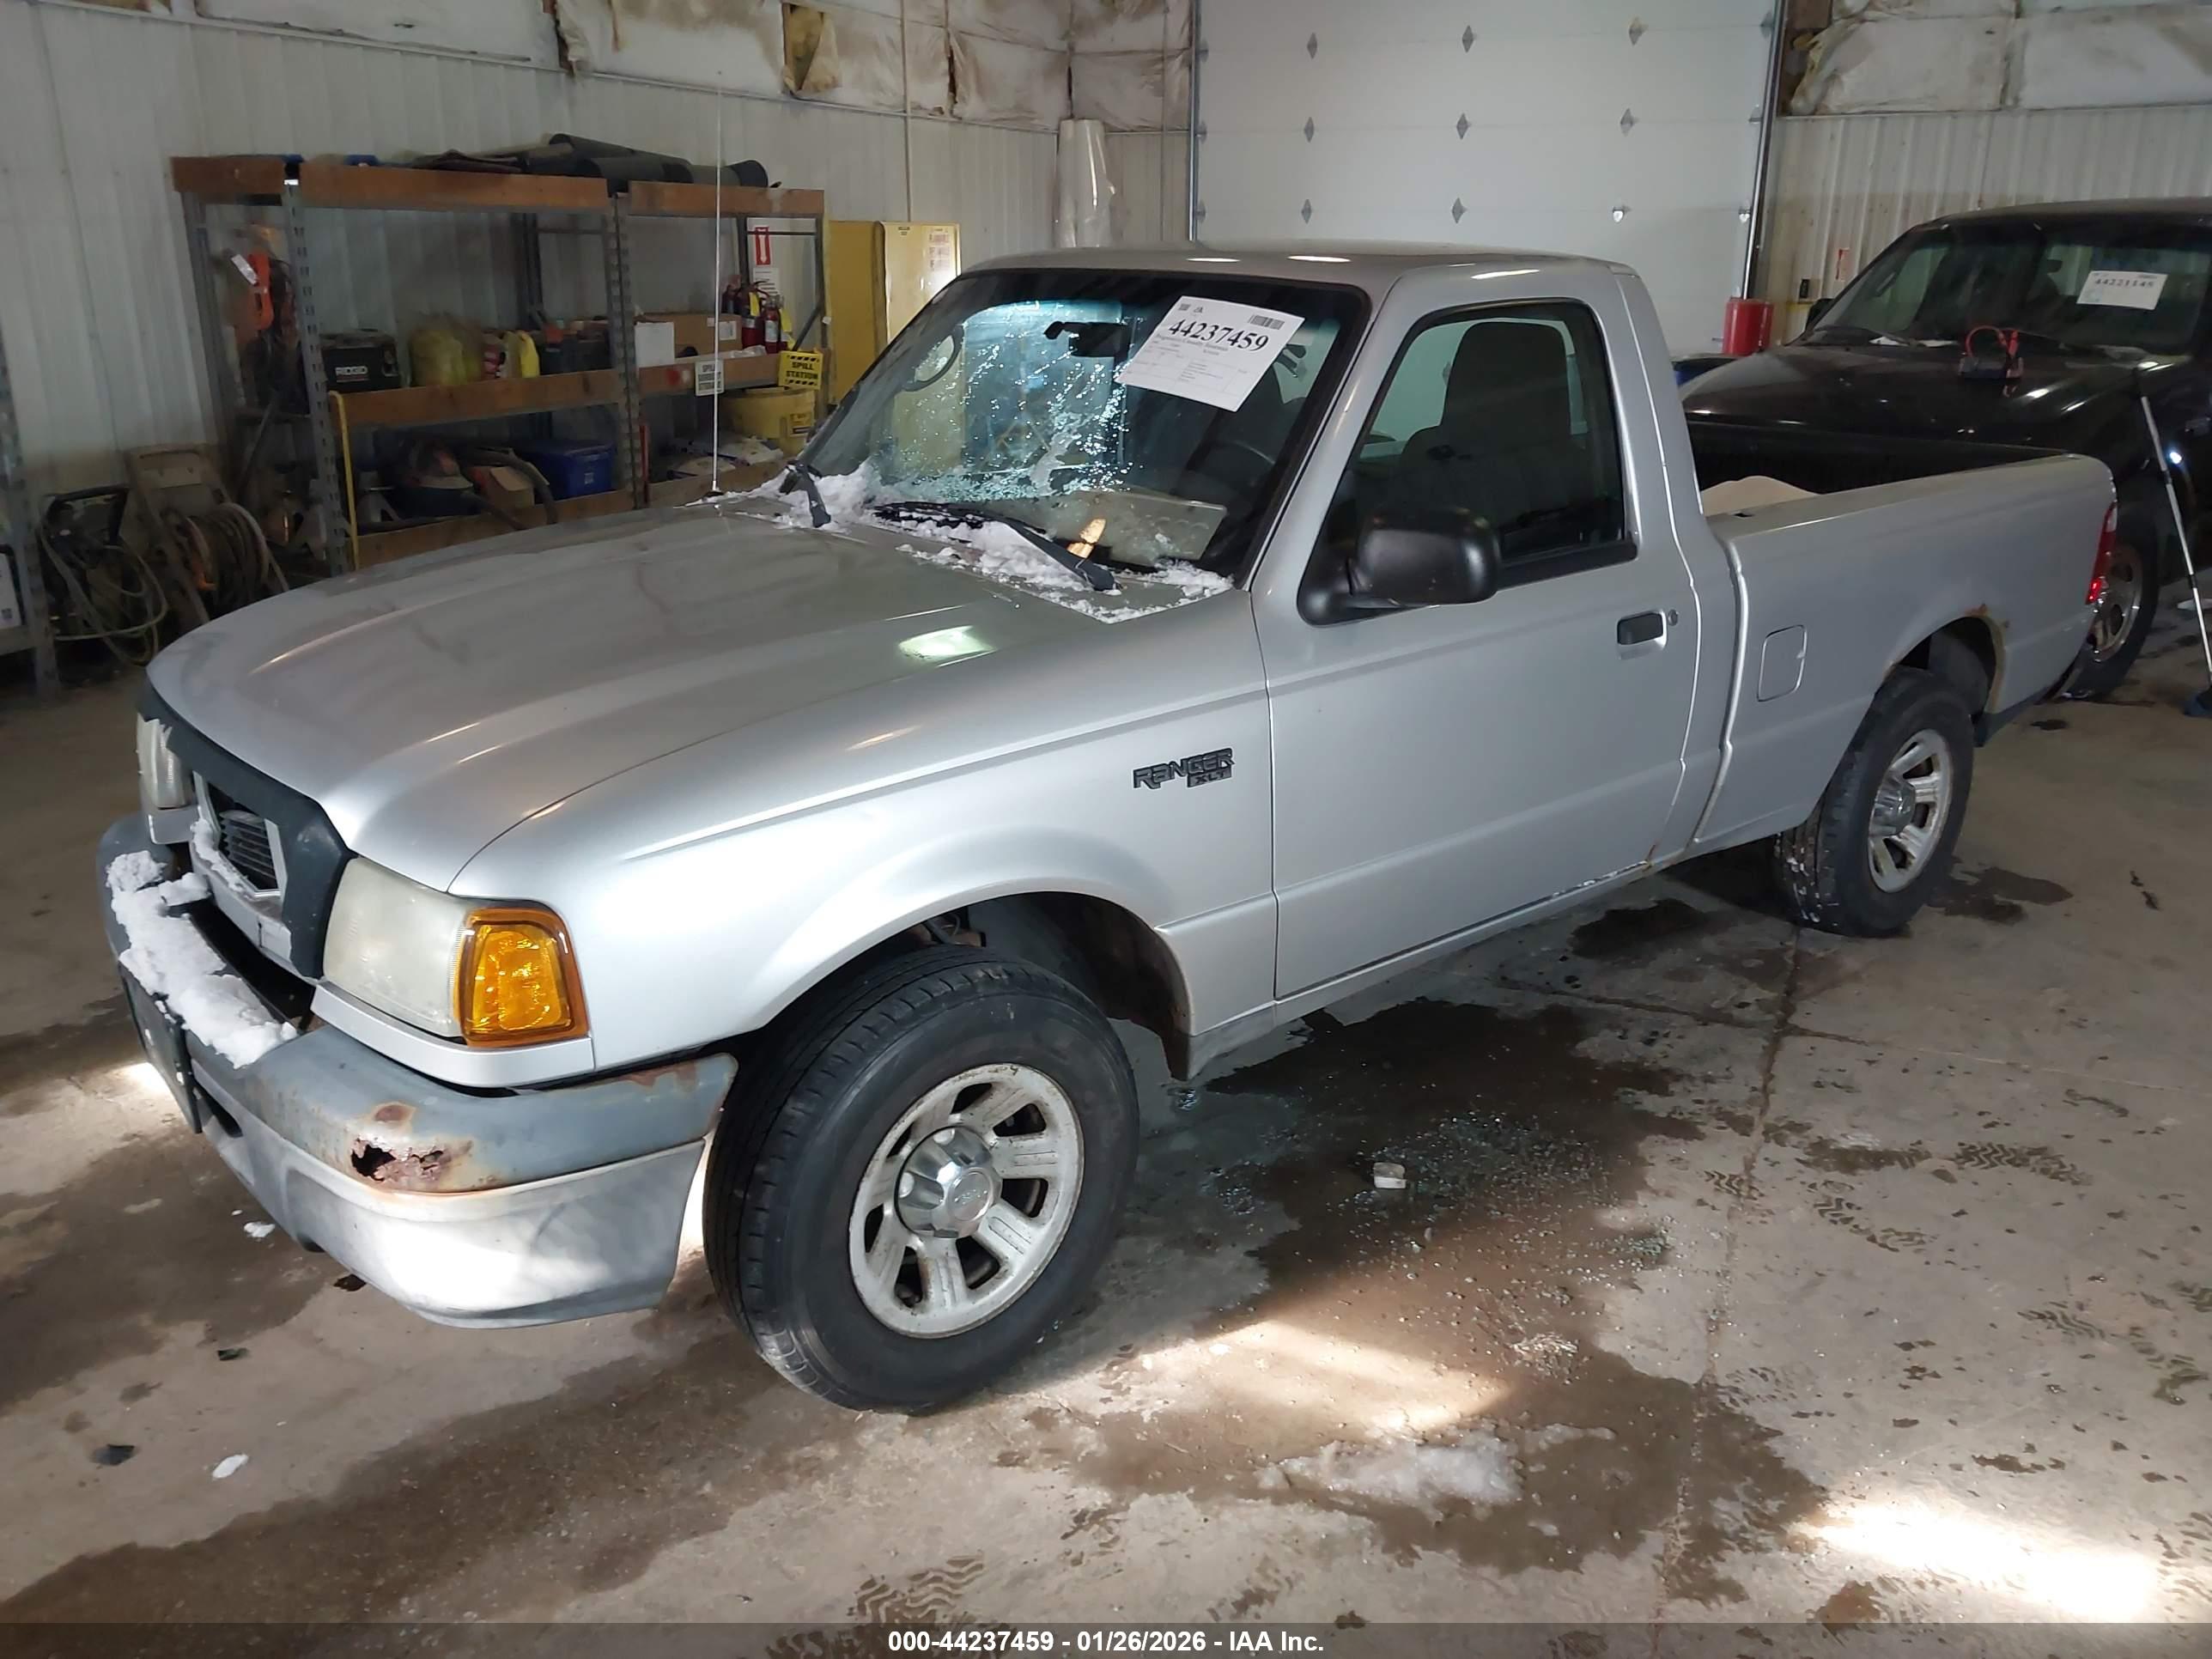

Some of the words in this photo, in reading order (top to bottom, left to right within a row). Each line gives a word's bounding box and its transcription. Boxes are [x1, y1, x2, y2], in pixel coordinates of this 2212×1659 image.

[1169, 319, 1270, 351] 44237459
[786, 370, 818, 380] STATION
[792, 362, 814, 370] SPILL
[1133, 747, 1236, 789] RANGER
